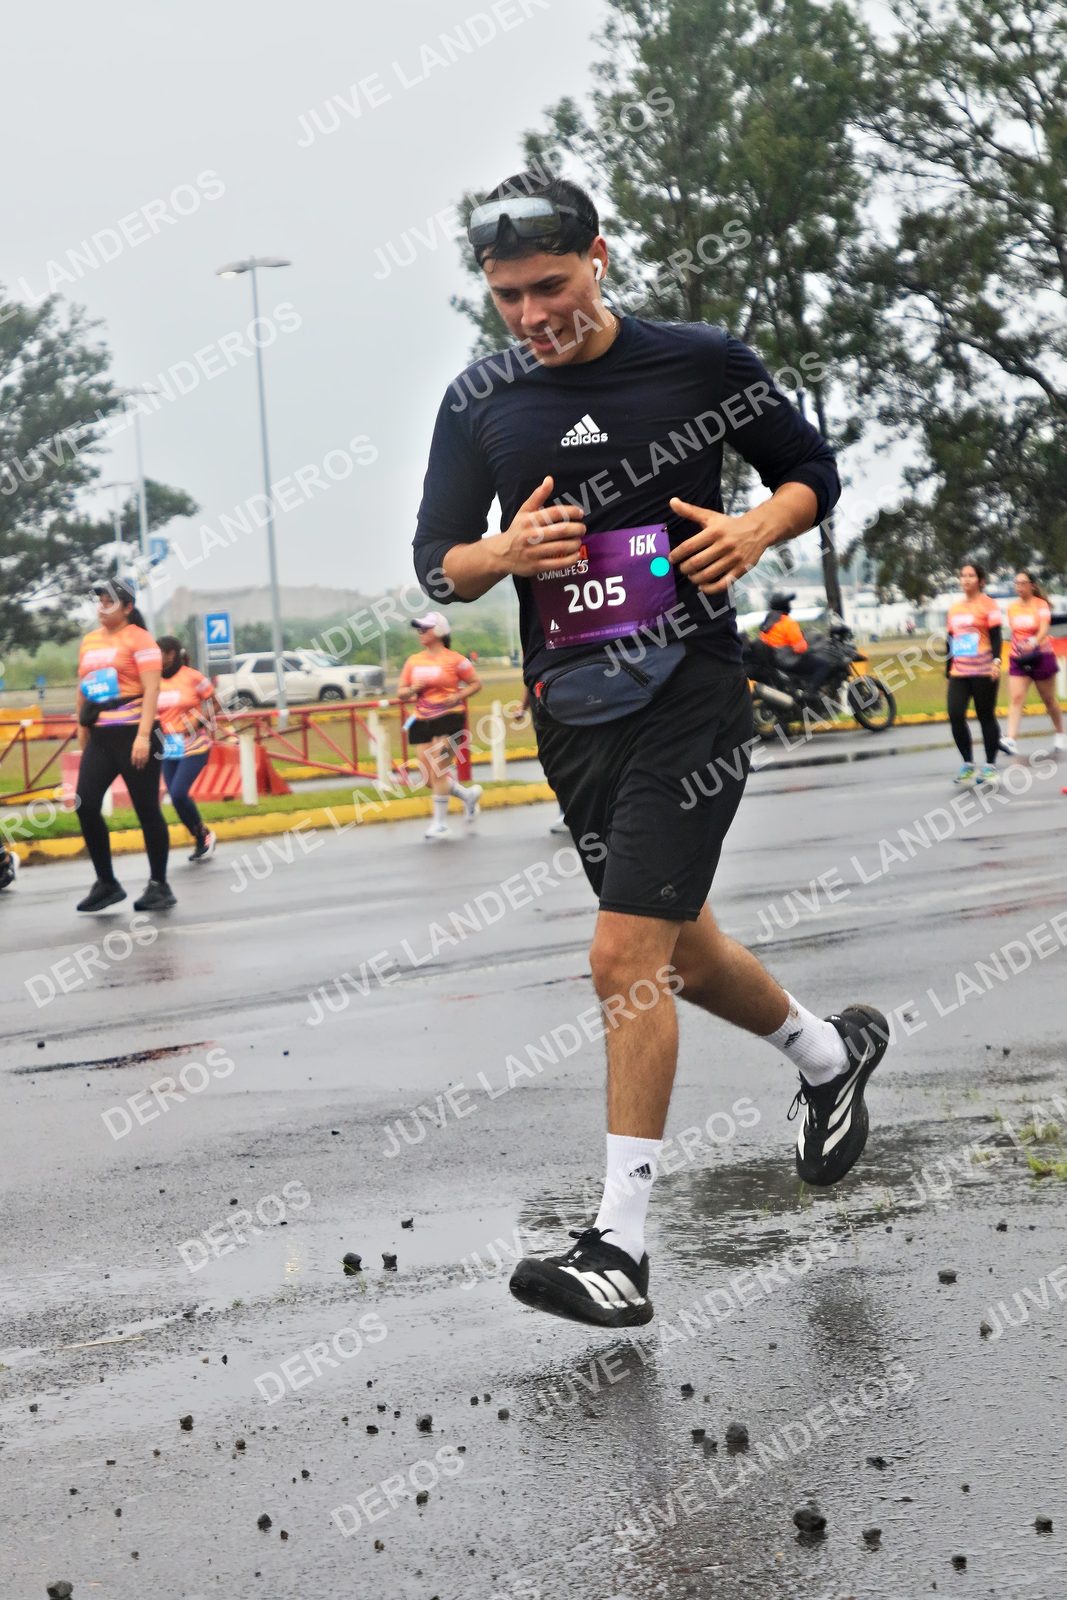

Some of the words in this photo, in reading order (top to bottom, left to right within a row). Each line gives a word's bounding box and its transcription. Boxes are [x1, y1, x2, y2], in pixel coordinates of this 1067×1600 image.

[560, 430, 608, 447] adidas
[537, 566, 577, 581] OMNILIFE
[563, 575, 627, 614] 205
